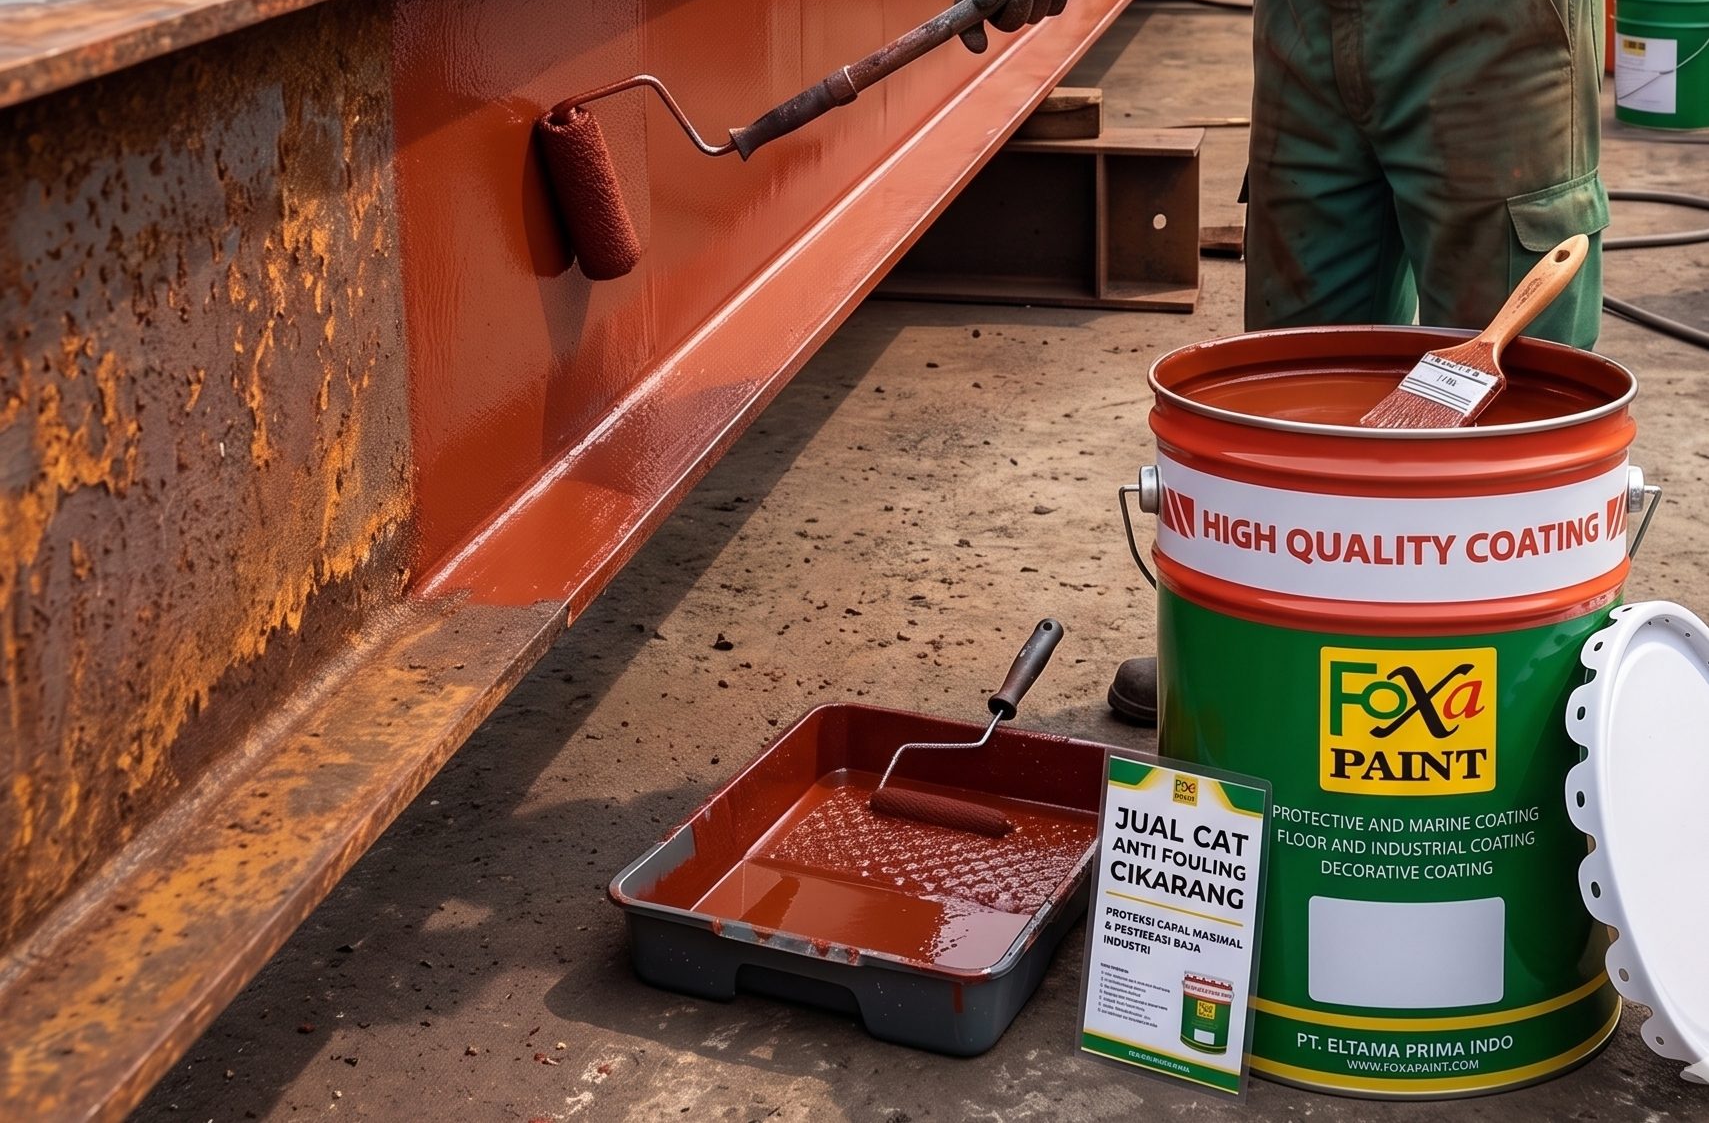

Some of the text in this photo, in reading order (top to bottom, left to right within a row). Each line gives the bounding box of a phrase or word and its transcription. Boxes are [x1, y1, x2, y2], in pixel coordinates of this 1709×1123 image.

[1203, 509, 1599, 565] HIGH QUALITY COATING
[1330, 748, 1487, 781] PAINT
[1115, 806, 1249, 856] JUAL CAT
[1272, 805, 1539, 833] PROTECTIVE AND MARINE COATING
[1277, 829, 1535, 856] FLOOR AND INDUSTRIAL COATING
[1112, 837, 1246, 881] ANTI FOULING
[1321, 860, 1493, 879] DECORATIVE COATING
[1110, 860, 1244, 909] CIKARANG
[1106, 907, 1155, 927] PROTEKSI
[1104, 921, 1112, 930] &
[1174, 938, 1201, 953] BAJA
[1104, 934, 1150, 955] INDUSTRI
[1297, 1032, 1513, 1058] PT. ELTAMA PRIMA INDO
[1347, 1059, 1479, 1073] WWW.FOXAPAINT.COM
